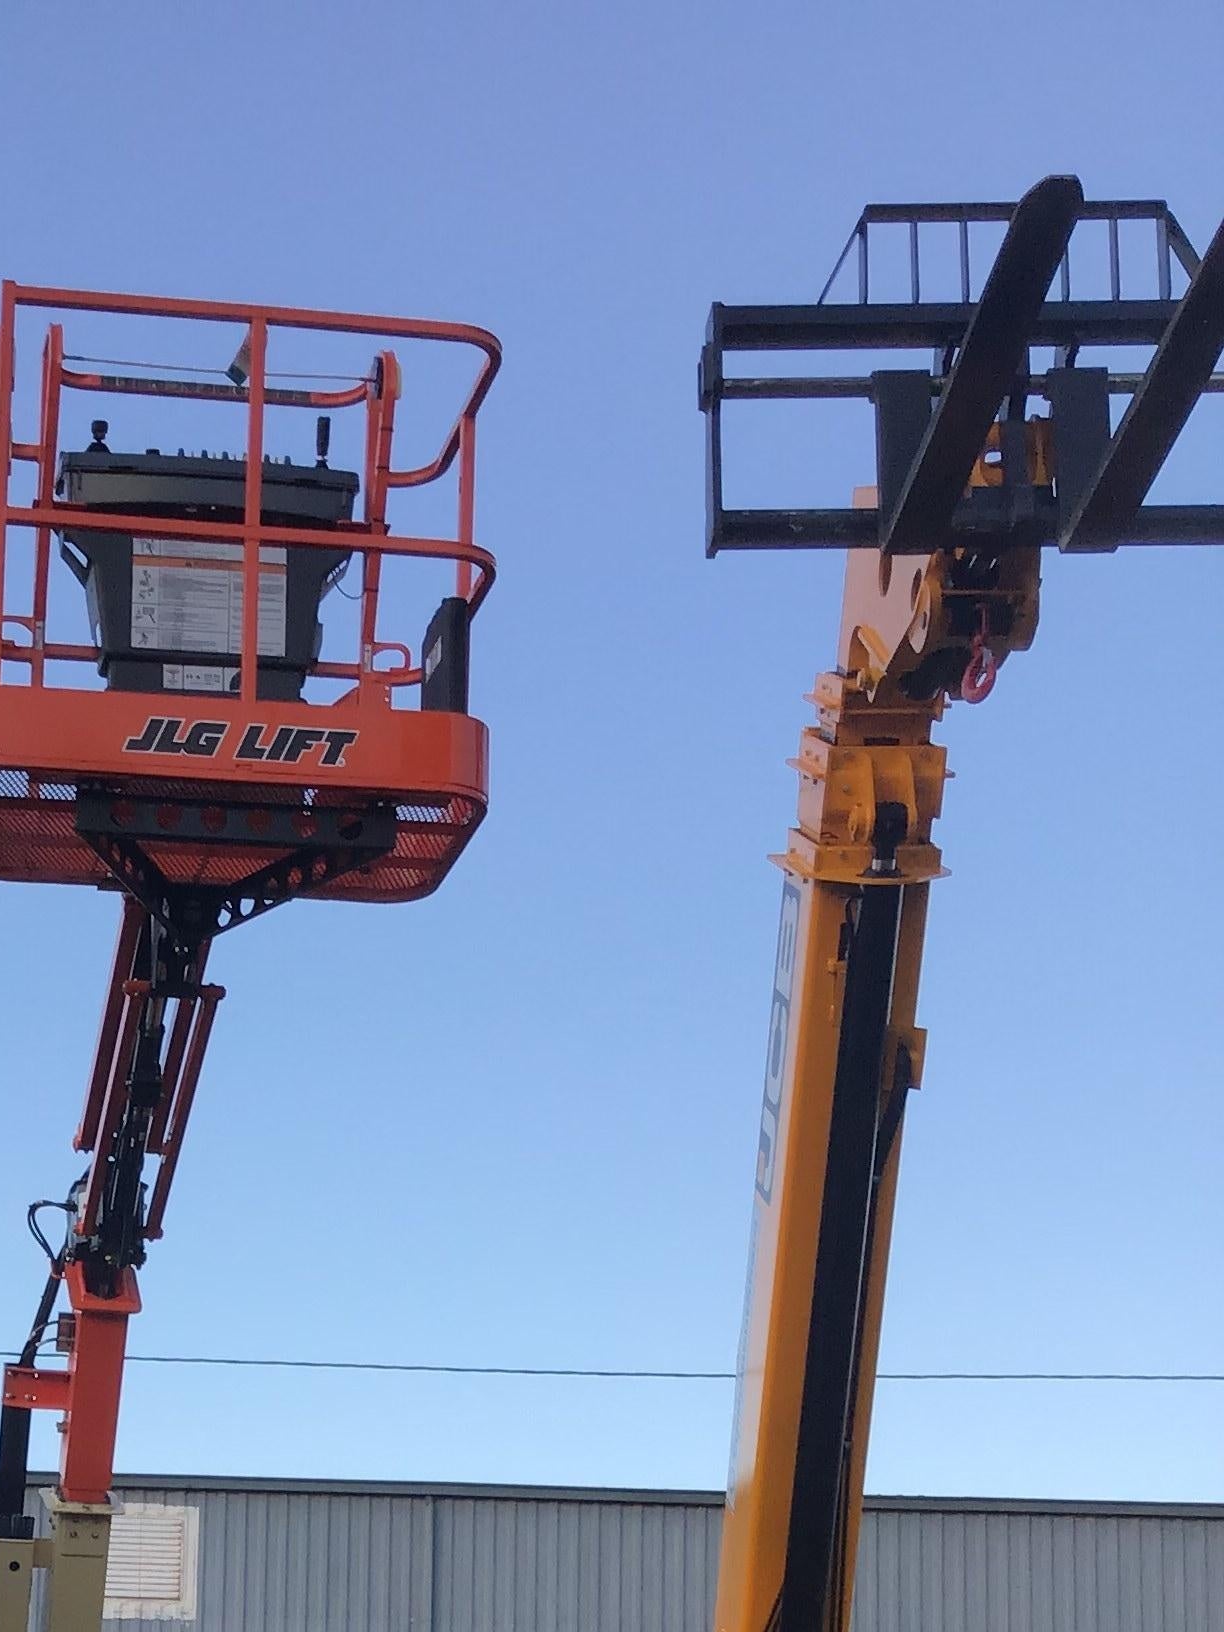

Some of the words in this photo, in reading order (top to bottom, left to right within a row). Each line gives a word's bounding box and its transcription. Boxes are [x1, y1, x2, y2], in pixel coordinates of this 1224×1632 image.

[122, 715, 231, 759] JLG
[233, 722, 360, 768] LIFT
[755, 890, 801, 1196] JCB
